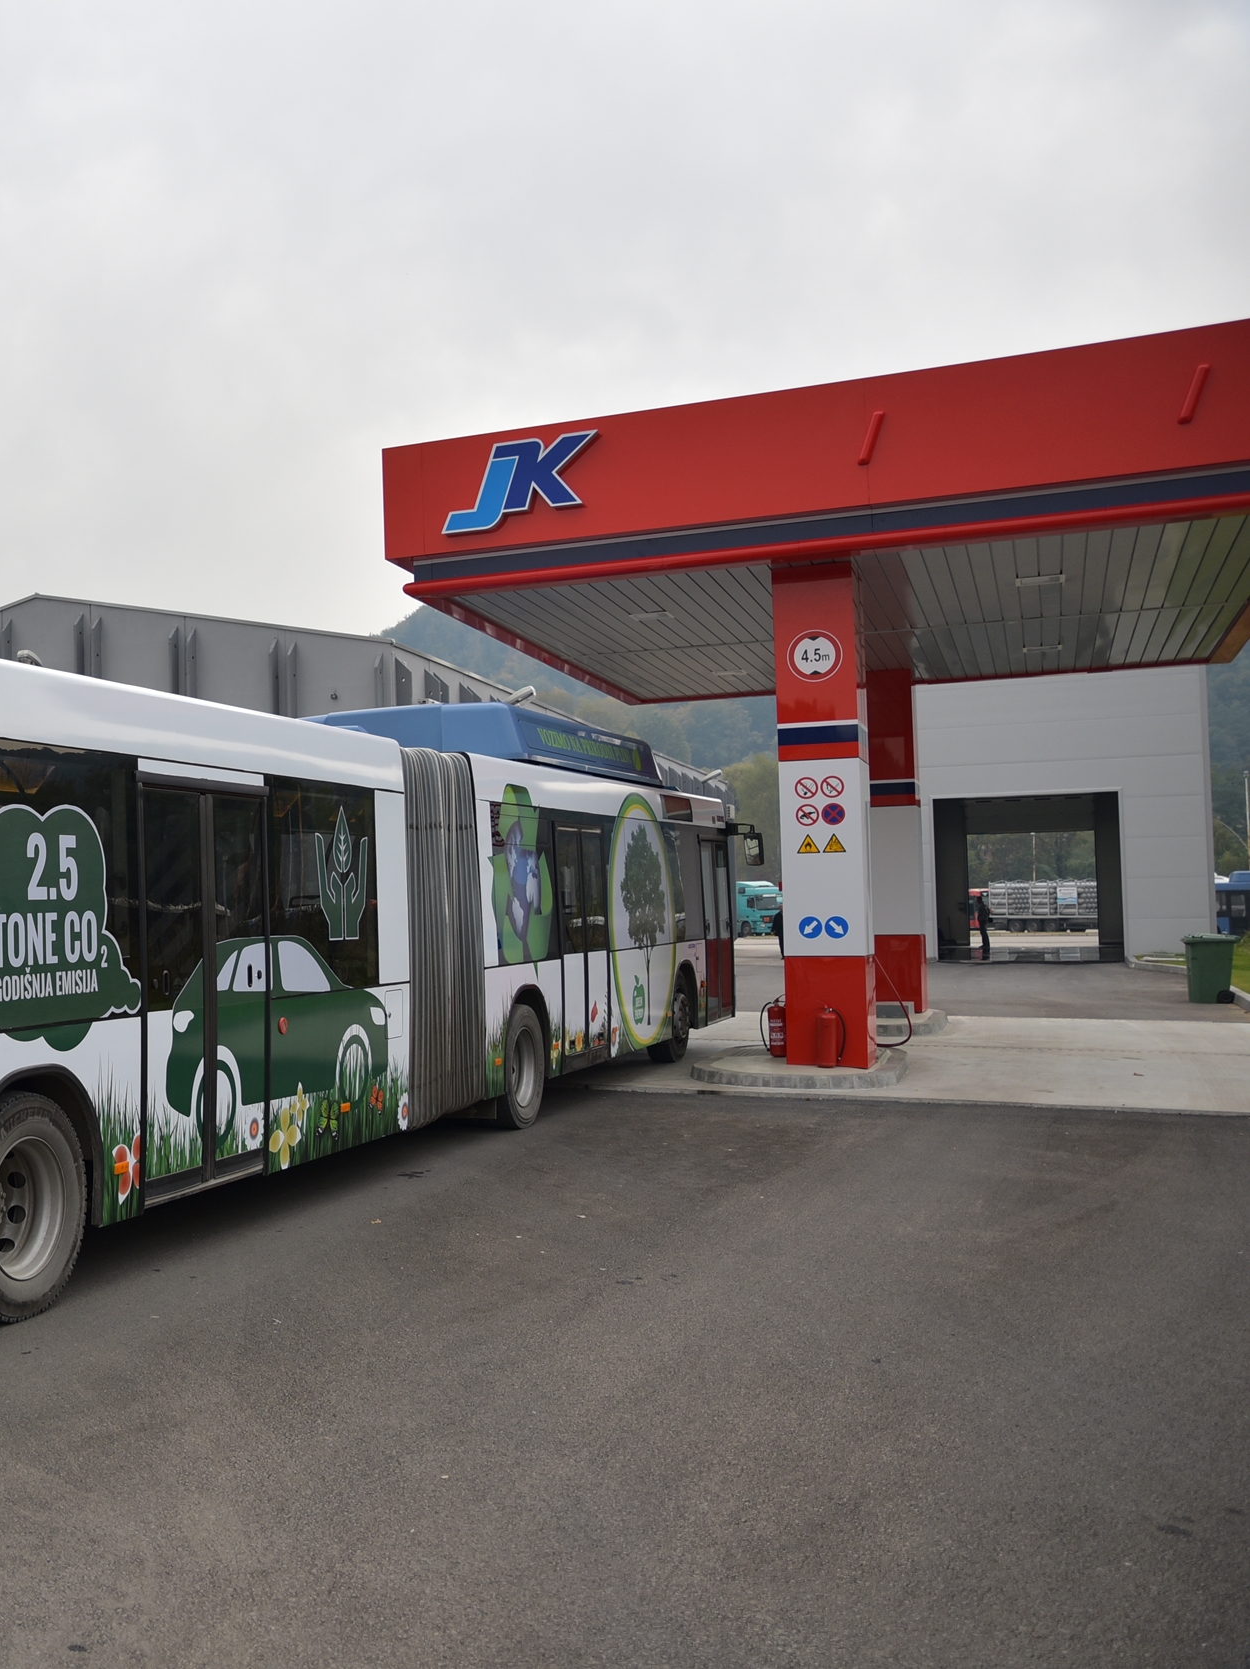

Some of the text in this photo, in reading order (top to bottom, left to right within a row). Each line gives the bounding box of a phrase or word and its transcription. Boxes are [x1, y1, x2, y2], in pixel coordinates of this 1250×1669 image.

[441, 429, 598, 534] JK
[801, 648, 830, 663] 4.5m
[26, 832, 79, 901] 2.5
[55, 968, 99, 996] EMISIJA
